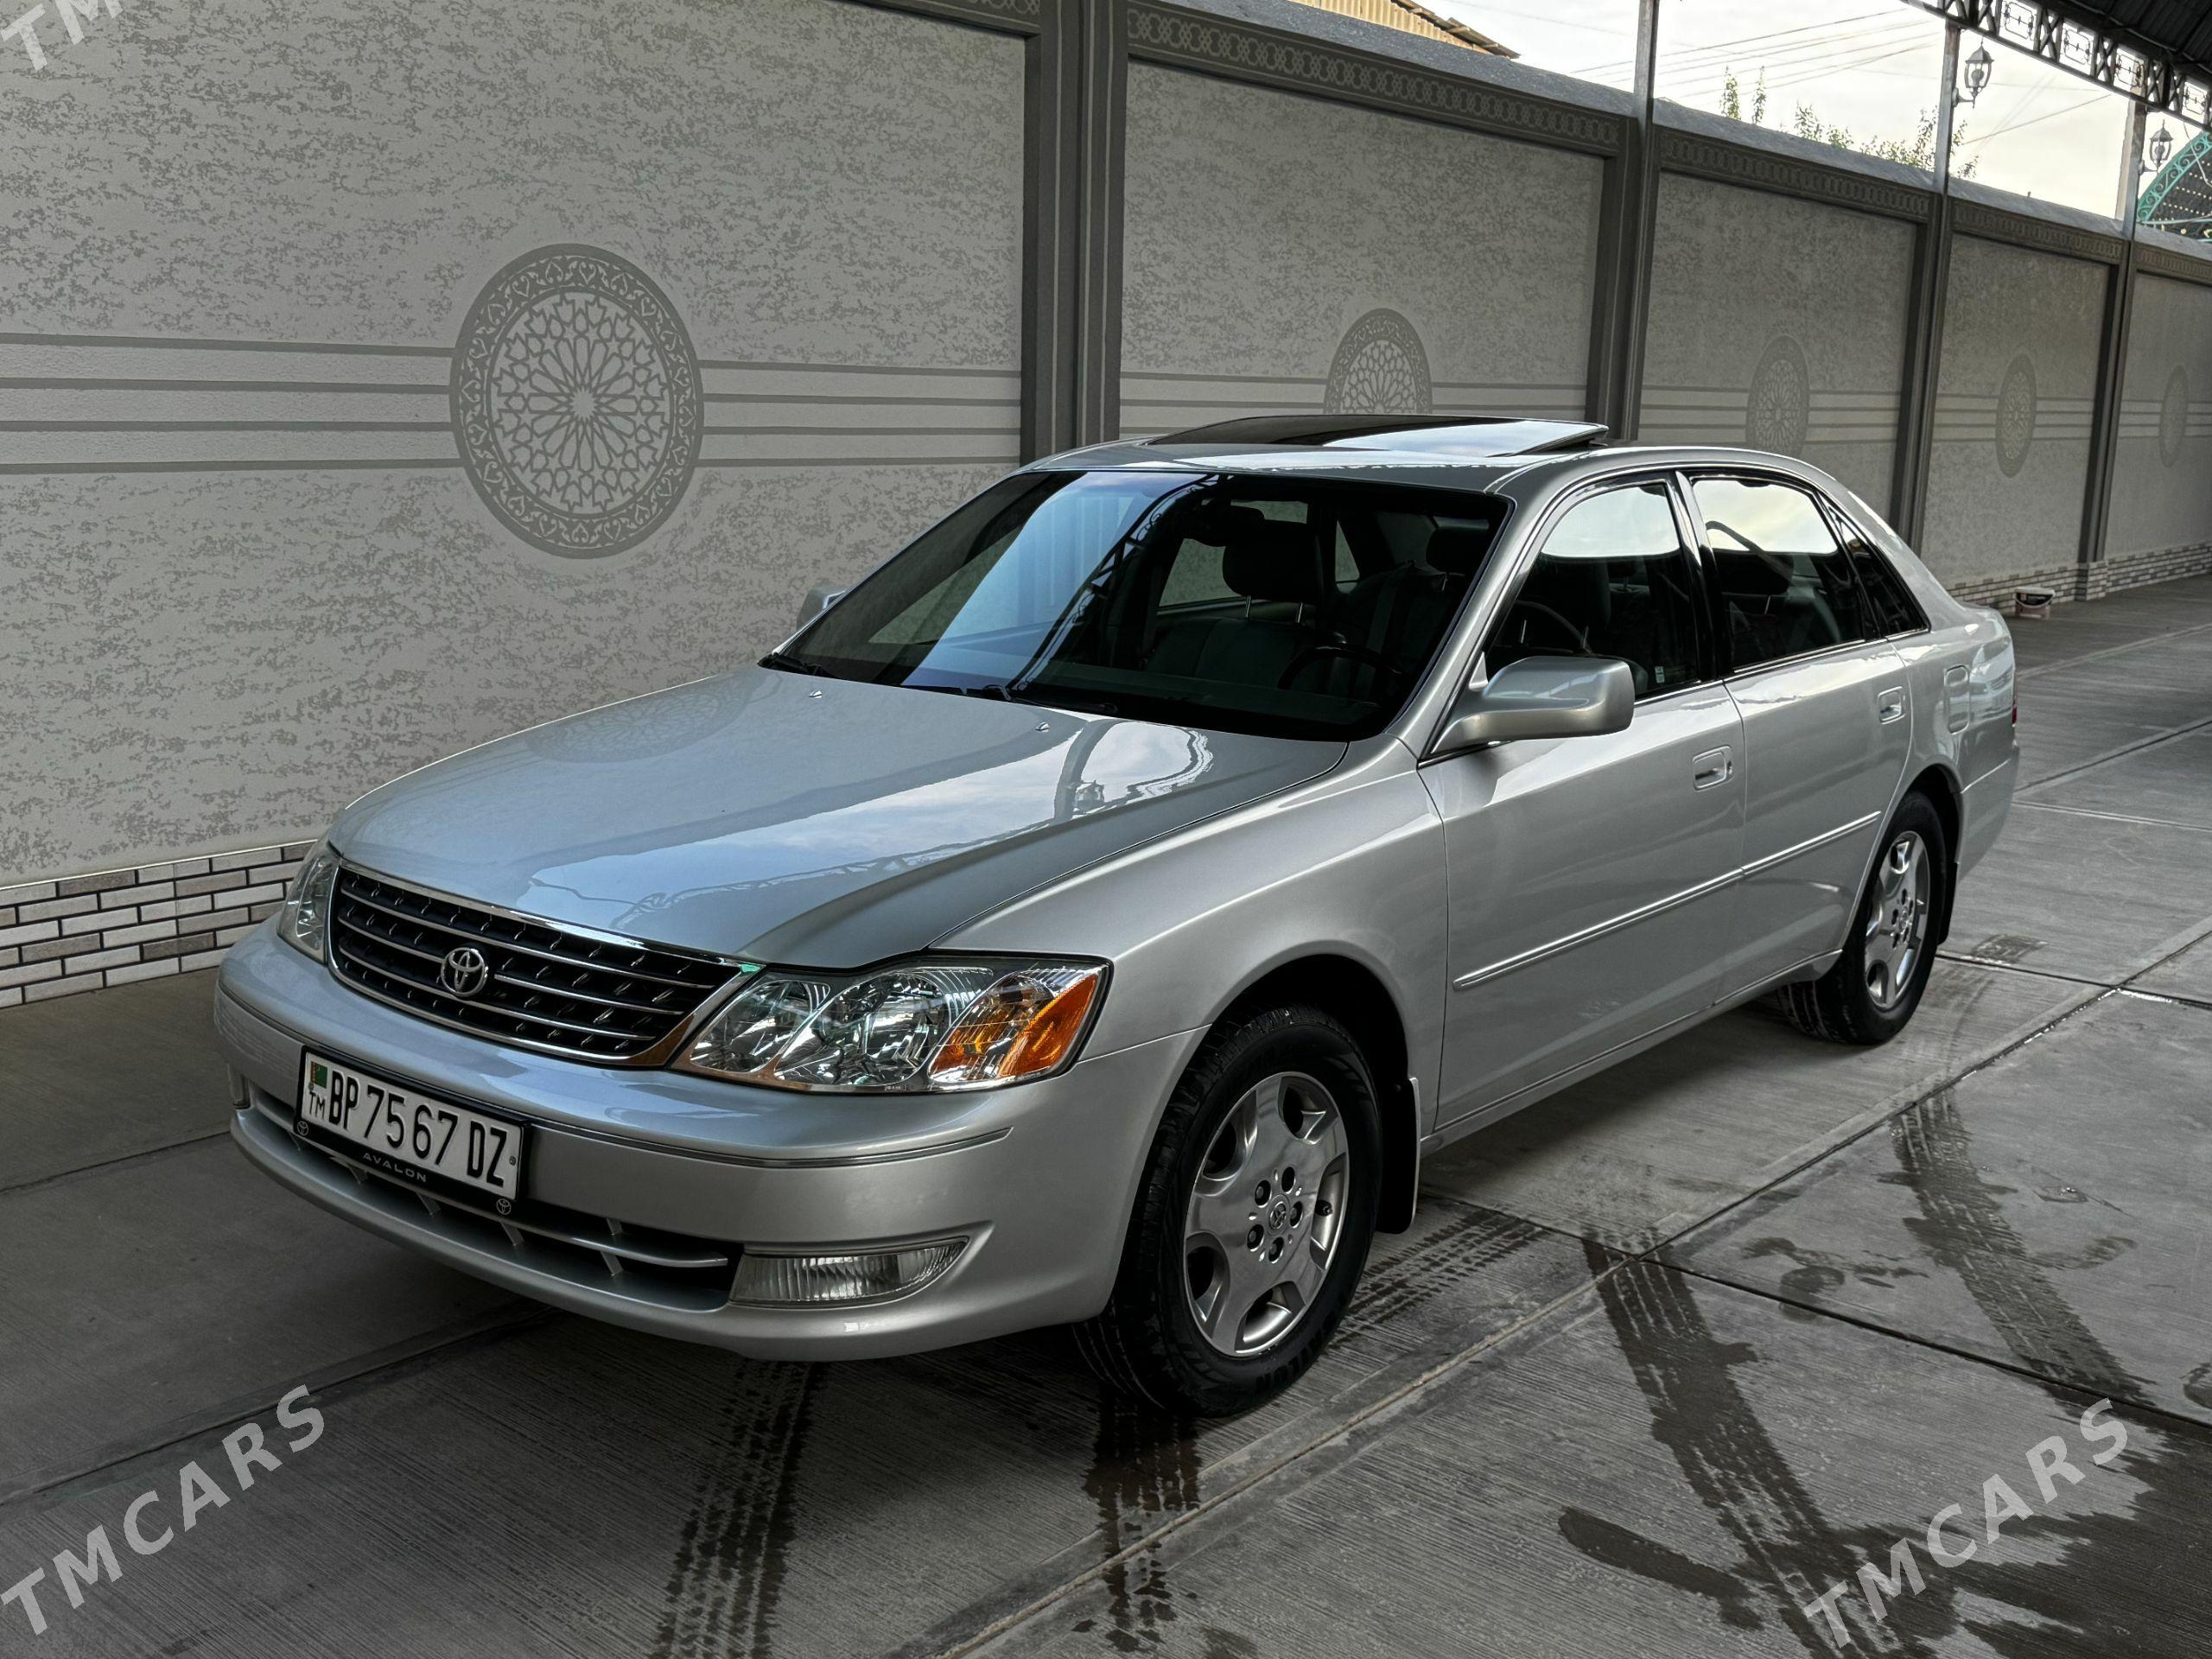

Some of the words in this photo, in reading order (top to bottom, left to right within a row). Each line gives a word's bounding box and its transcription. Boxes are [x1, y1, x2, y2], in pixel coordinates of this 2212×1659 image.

[308, 1090, 326, 1120] TM
[329, 1071, 359, 1129] BP
[365, 1084, 459, 1166] 7567
[467, 1121, 507, 1187] DZ
[362, 1153, 427, 1183] AVALON
